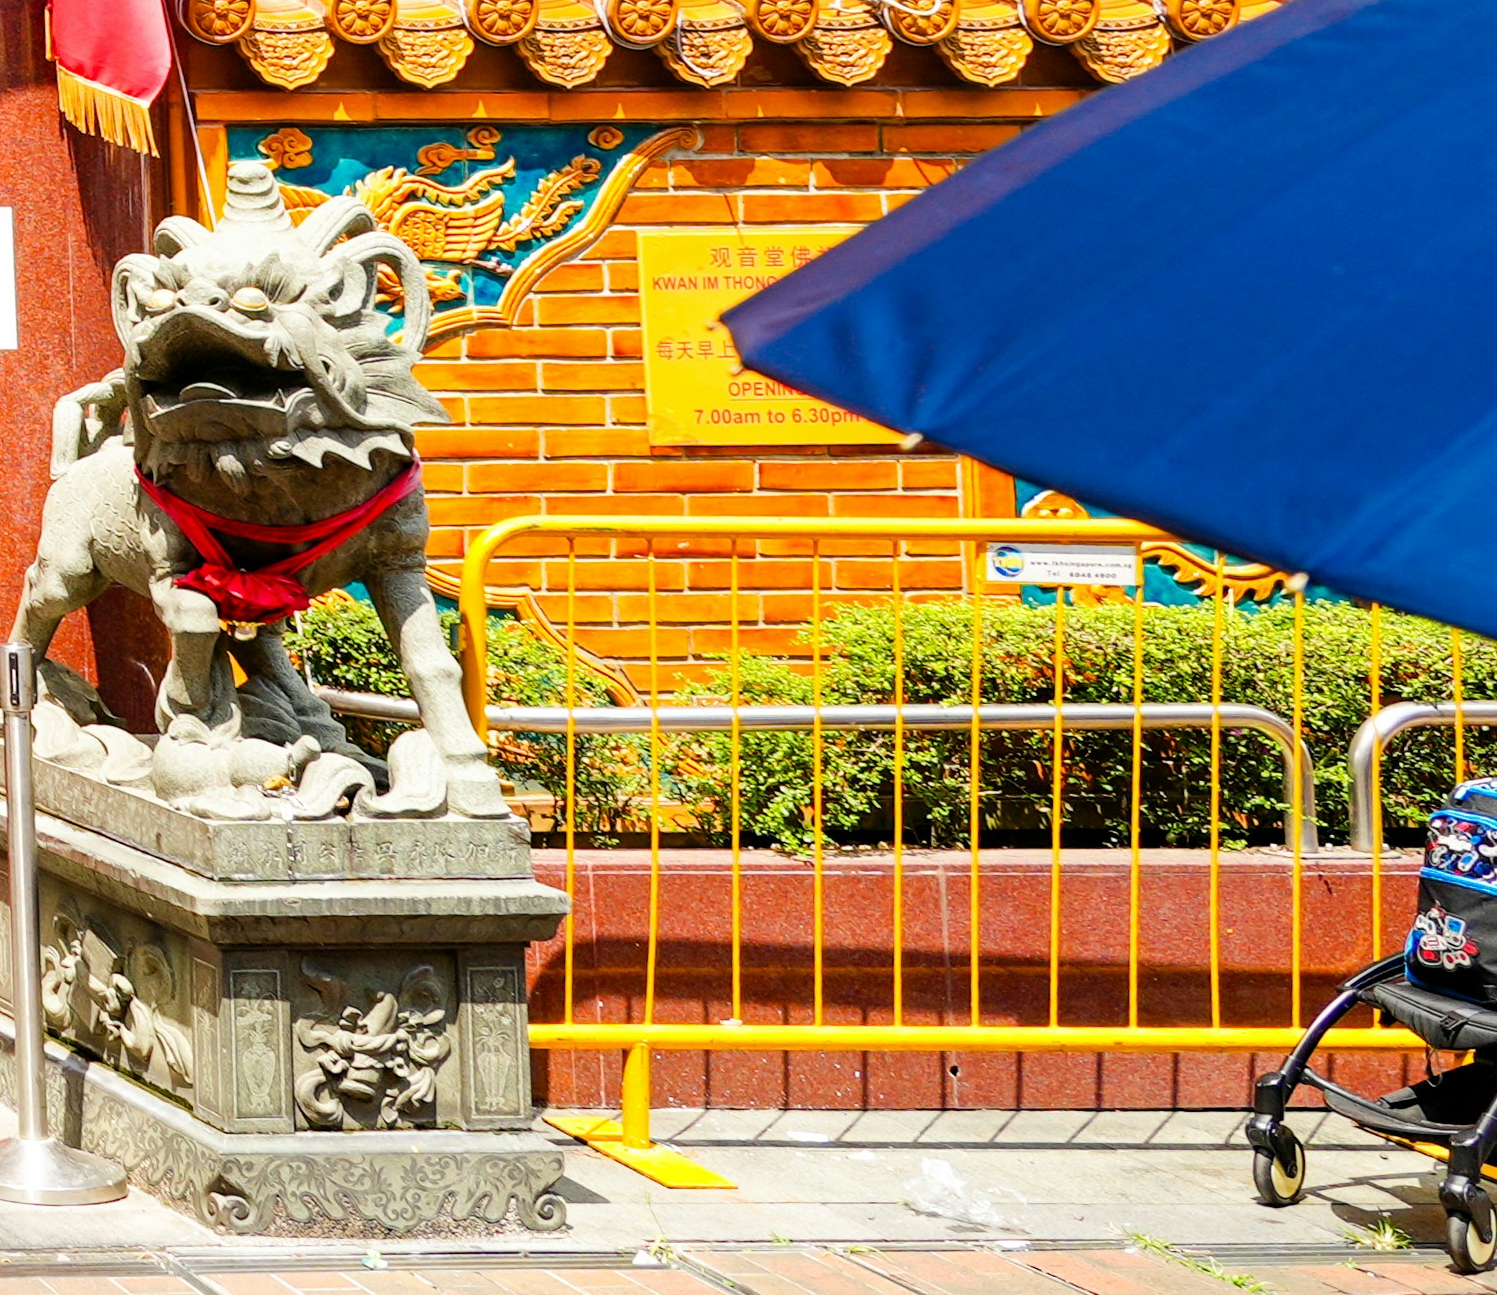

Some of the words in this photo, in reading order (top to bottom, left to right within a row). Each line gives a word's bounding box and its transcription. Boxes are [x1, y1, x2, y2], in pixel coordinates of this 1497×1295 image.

[710, 246, 830, 268] 观音堂佛
[652, 276, 697, 290] KWAN
[703, 276, 719, 290] IM
[694, 409, 761, 425] 7.00am
[767, 409, 785, 424] to
